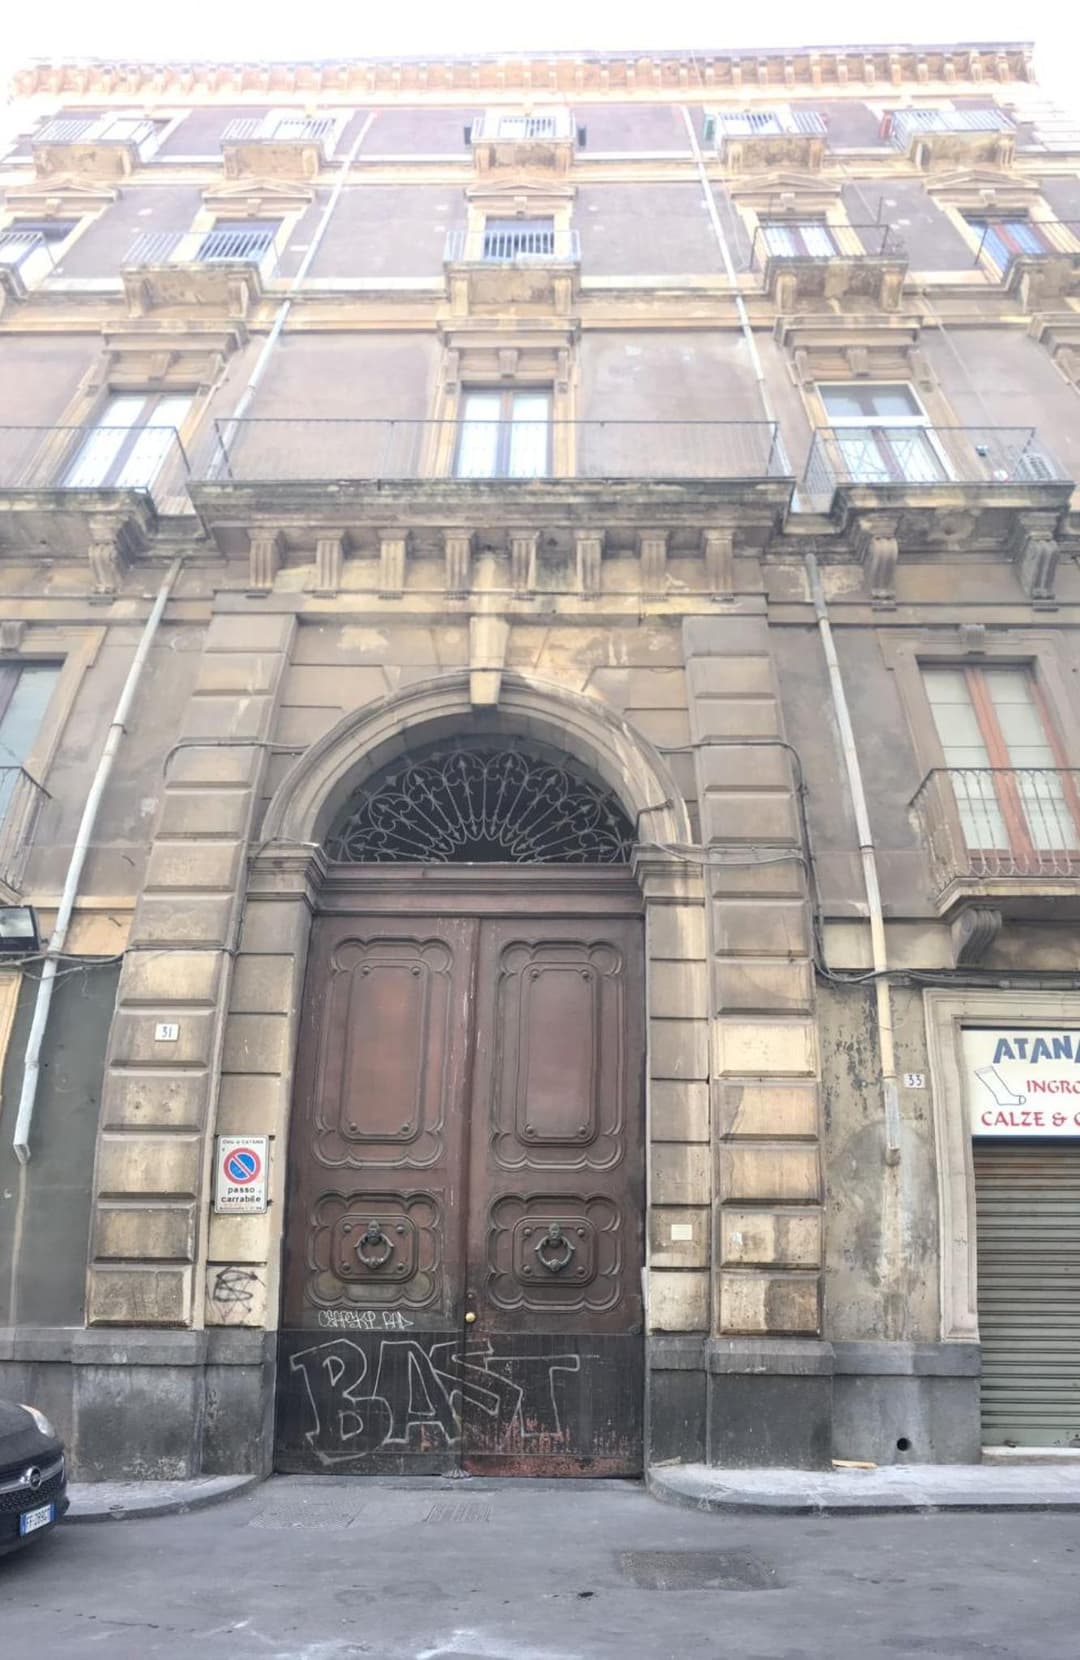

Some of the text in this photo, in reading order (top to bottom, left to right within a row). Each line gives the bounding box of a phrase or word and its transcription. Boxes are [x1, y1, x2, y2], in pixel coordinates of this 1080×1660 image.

[161, 1026, 173, 1038] 31
[993, 1035, 1080, 1064] ATAN
[908, 1074, 922, 1086] 33
[981, 1111, 1045, 1127] CALZE
[1052, 1112, 1067, 1127] &
[227, 1187, 255, 1195] passo
[221, 1195, 262, 1203] carrabile
